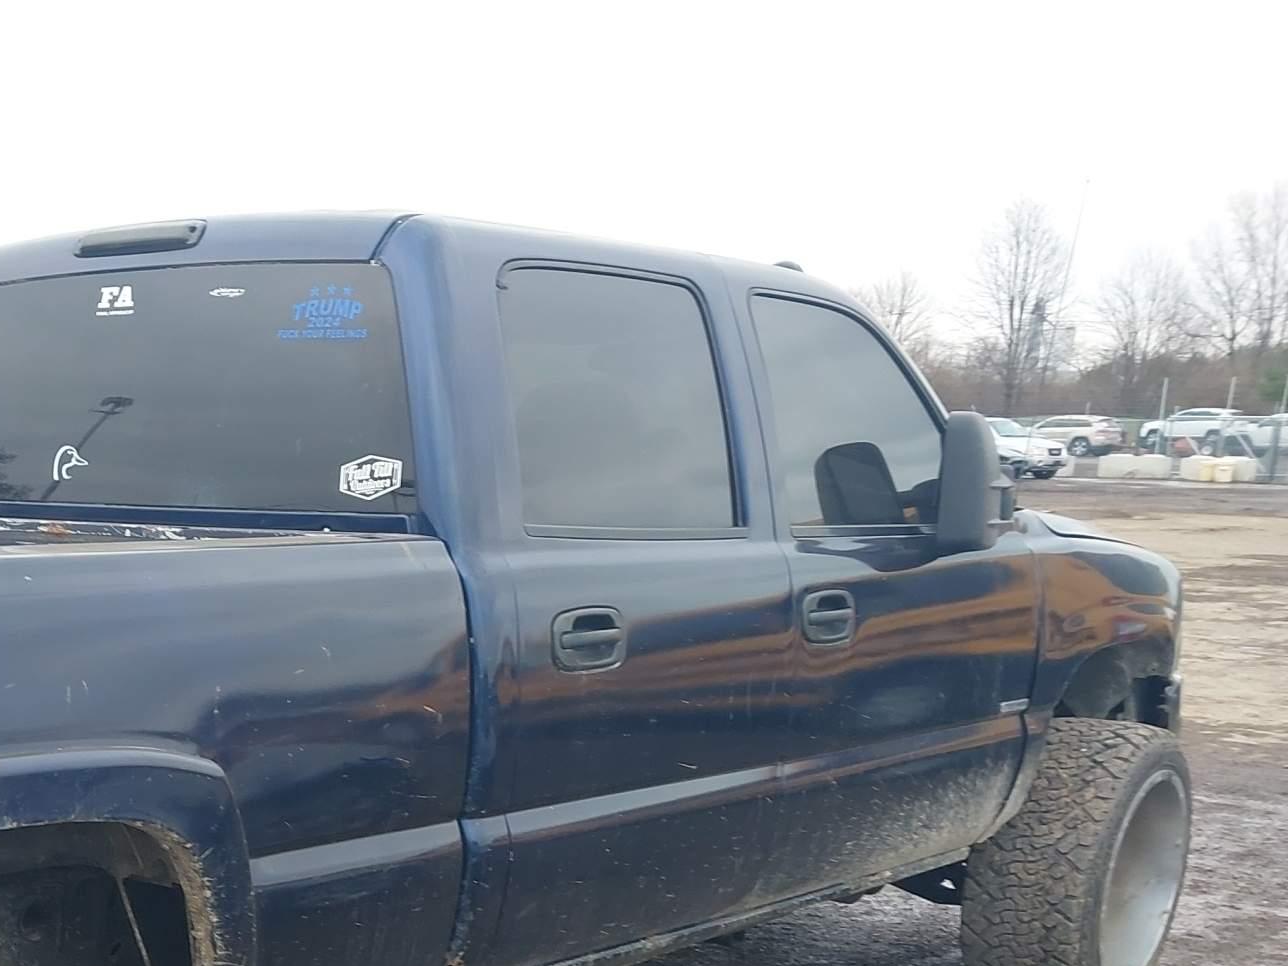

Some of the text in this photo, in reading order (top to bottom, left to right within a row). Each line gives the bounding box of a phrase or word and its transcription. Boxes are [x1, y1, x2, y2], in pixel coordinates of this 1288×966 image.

[97, 286, 134, 308] FA
[294, 299, 363, 320] TRUMP
[307, 316, 341, 328] 2024
[301, 329, 325, 338] YOUR
[326, 328, 367, 338] FEELINGS
